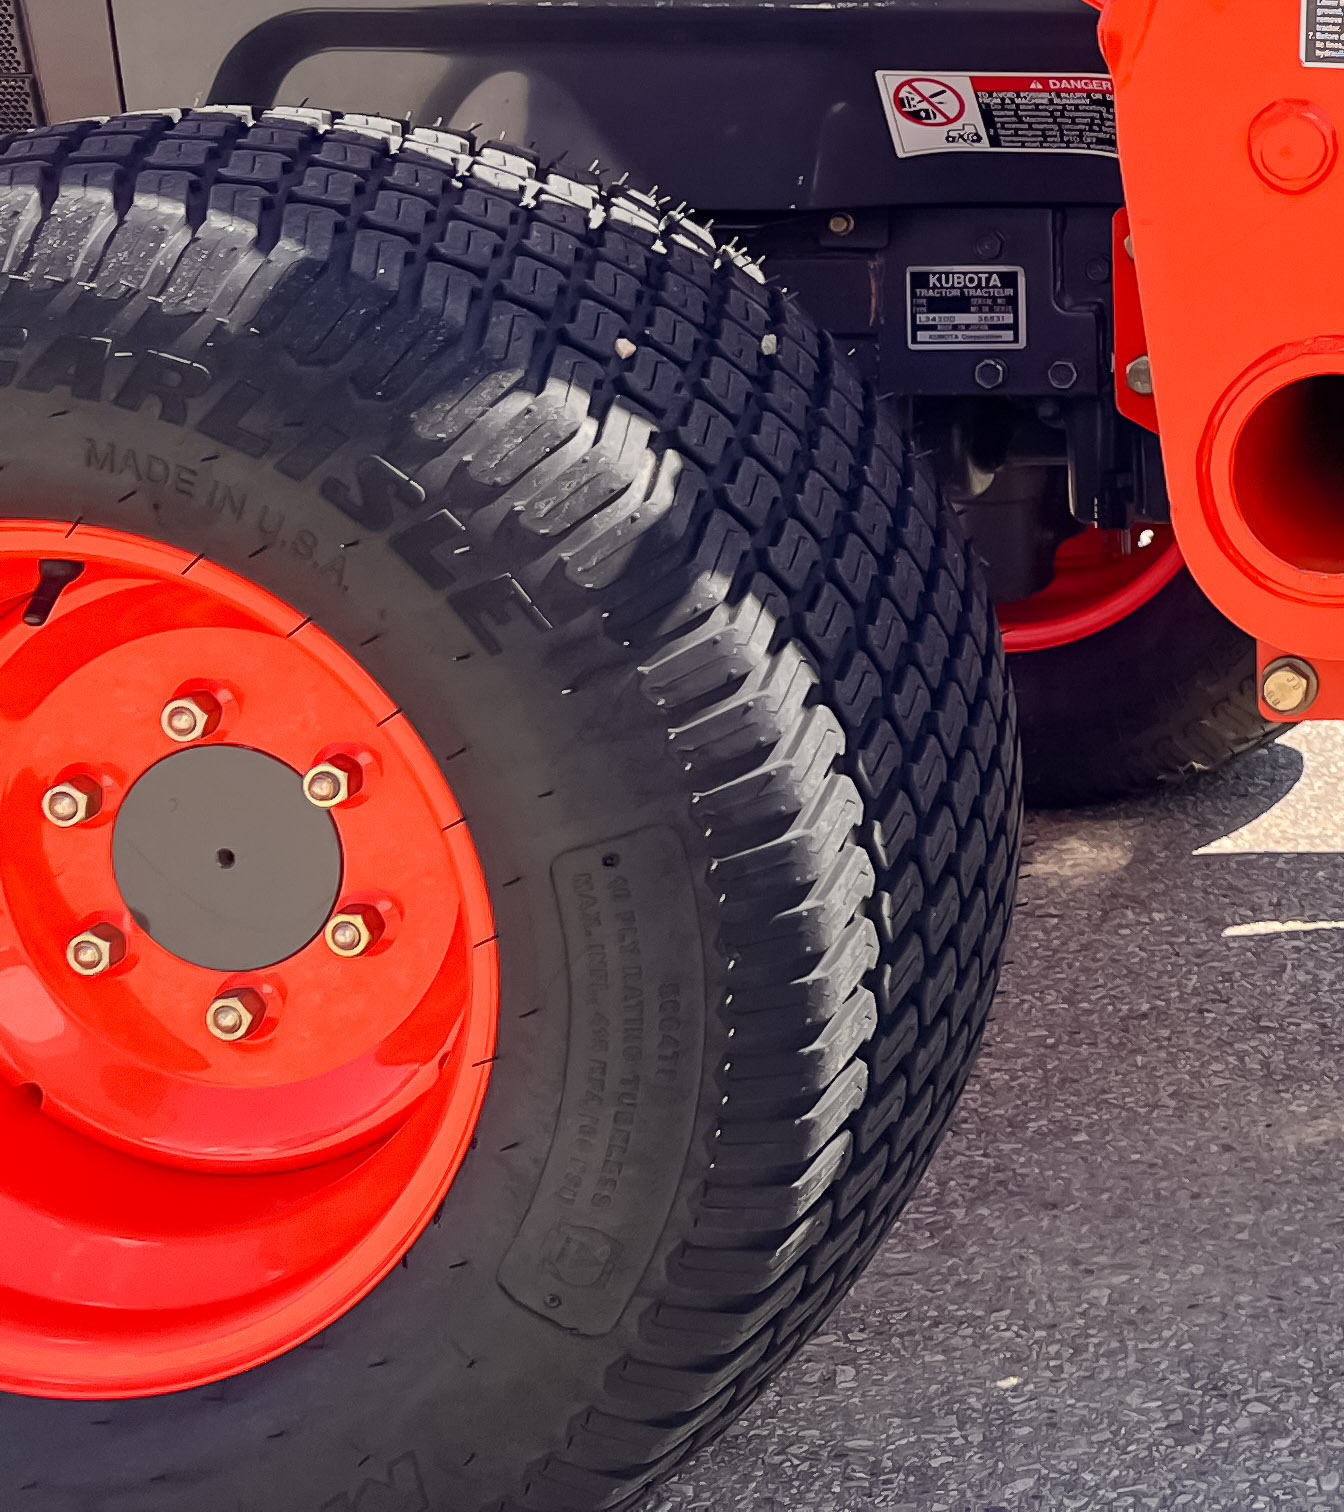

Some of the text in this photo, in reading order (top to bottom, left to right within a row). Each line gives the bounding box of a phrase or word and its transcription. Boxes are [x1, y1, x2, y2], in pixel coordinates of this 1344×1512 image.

[1049, 79, 1112, 90] DANGER
[929, 274, 1001, 287] KUBOTA
[83, 437, 198, 498] MADE
